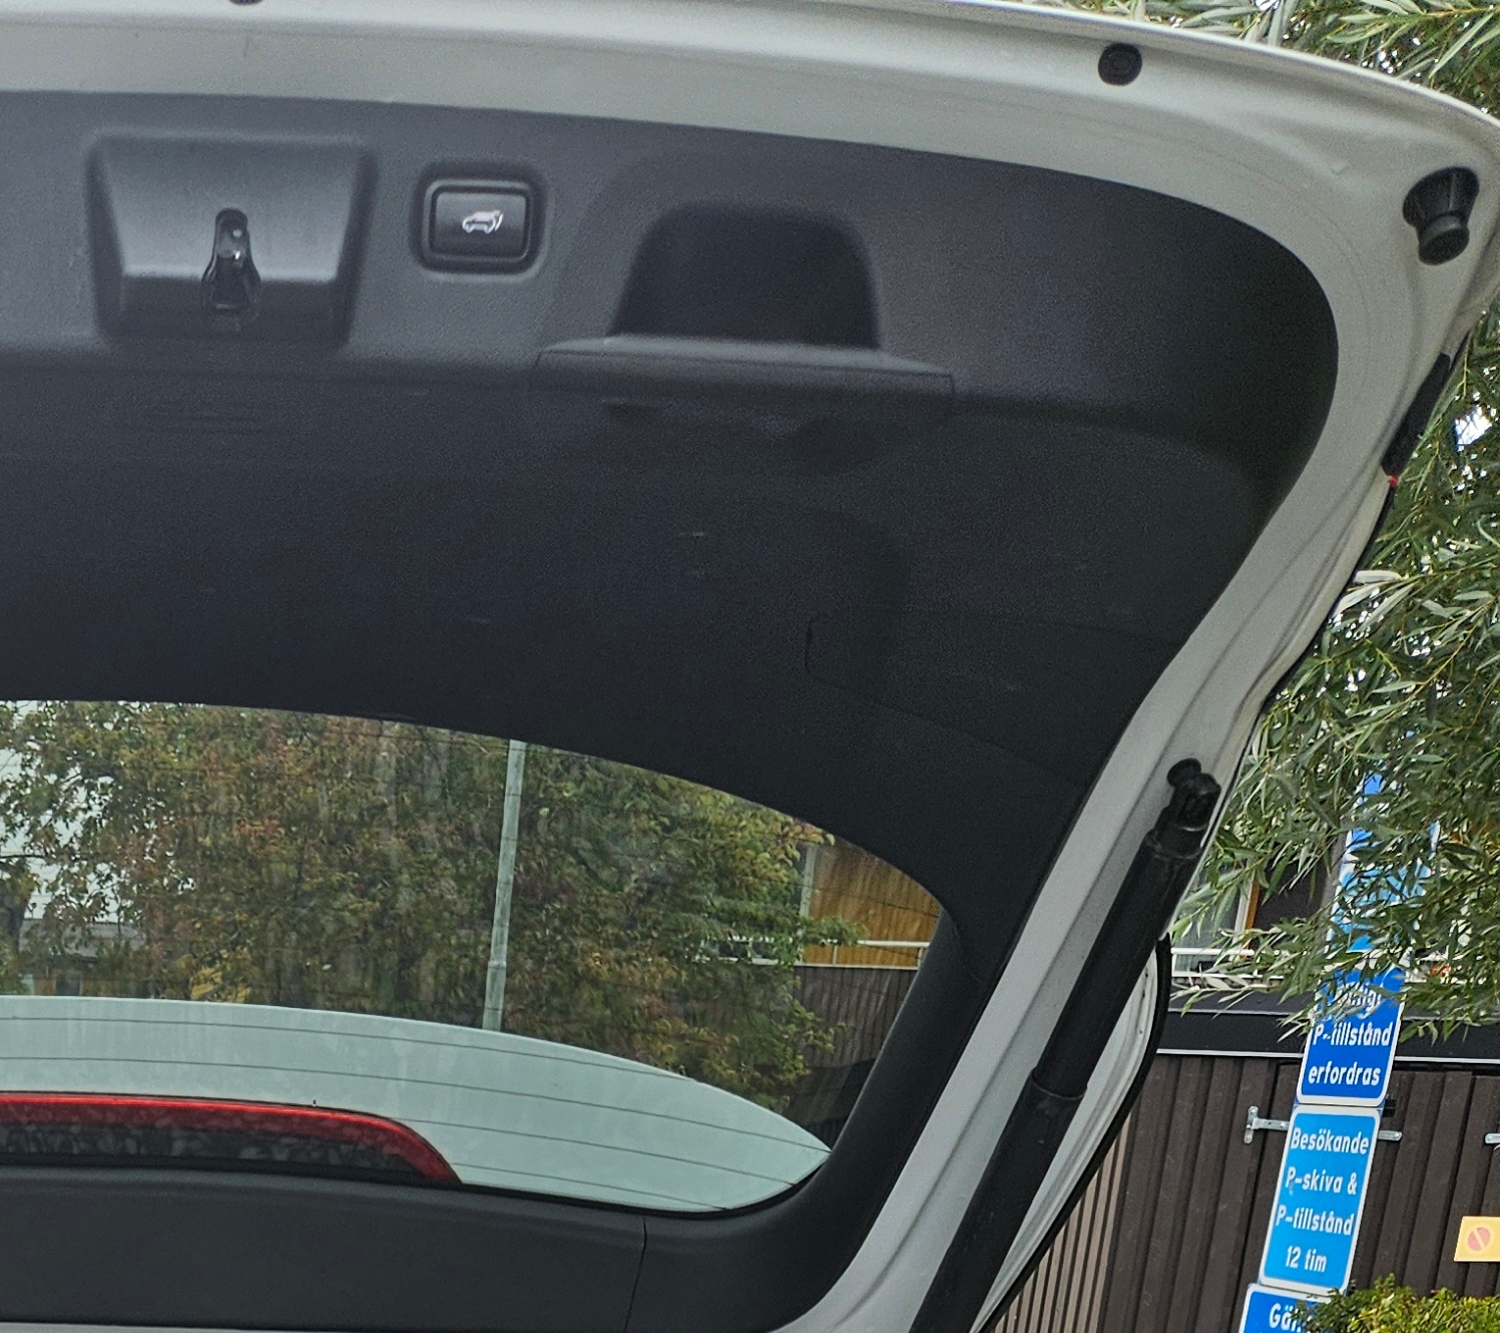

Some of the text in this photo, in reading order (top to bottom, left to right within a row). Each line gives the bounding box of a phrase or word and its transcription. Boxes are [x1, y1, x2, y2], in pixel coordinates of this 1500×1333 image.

[1312, 1021, 1393, 1046] P-tillstånd
[1308, 1061, 1381, 1086] erfordras
[1290, 1127, 1370, 1155] Besökande
[1285, 1166, 1358, 1195] P-skiva &
[1275, 1204, 1355, 1236] P-tillstånd
[1285, 1245, 1327, 1273] 12 tim
